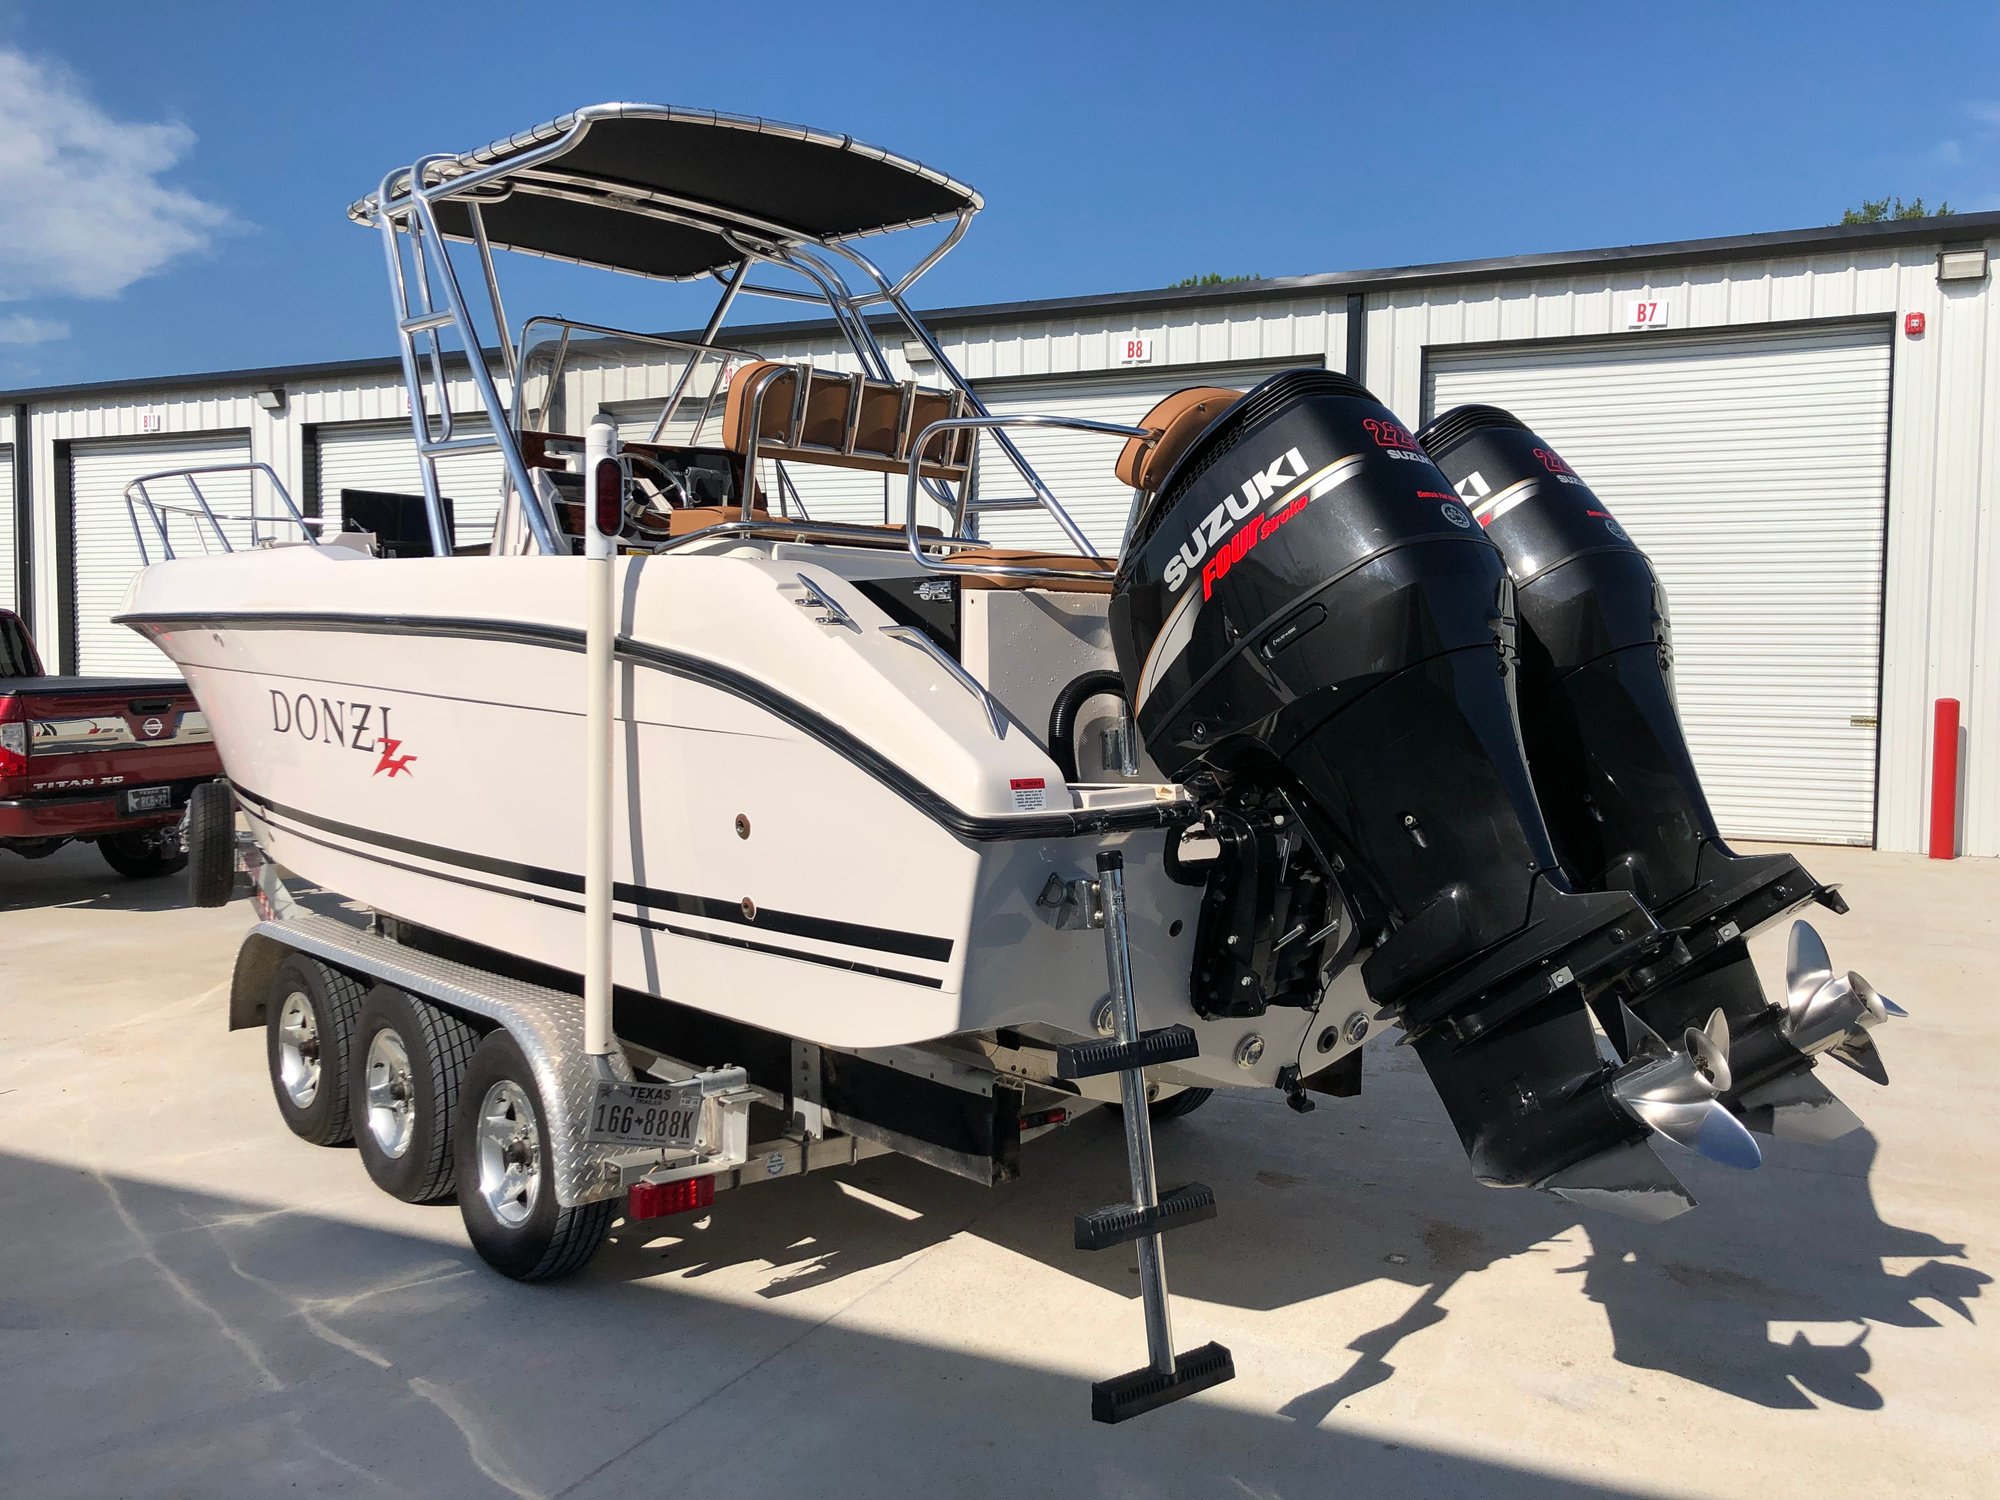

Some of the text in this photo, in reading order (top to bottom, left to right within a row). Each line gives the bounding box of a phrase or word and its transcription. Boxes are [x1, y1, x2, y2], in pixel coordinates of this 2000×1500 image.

[1636, 302, 1658, 323] B7
[1127, 340, 1143, 359] B8
[143, 414, 156, 428] B11
[1163, 446, 1310, 593] SUZUKI
[269, 689, 394, 757] DONZI
[33, 775, 124, 790] TITAN XD
[629, 1086, 672, 1101] TEXAS
